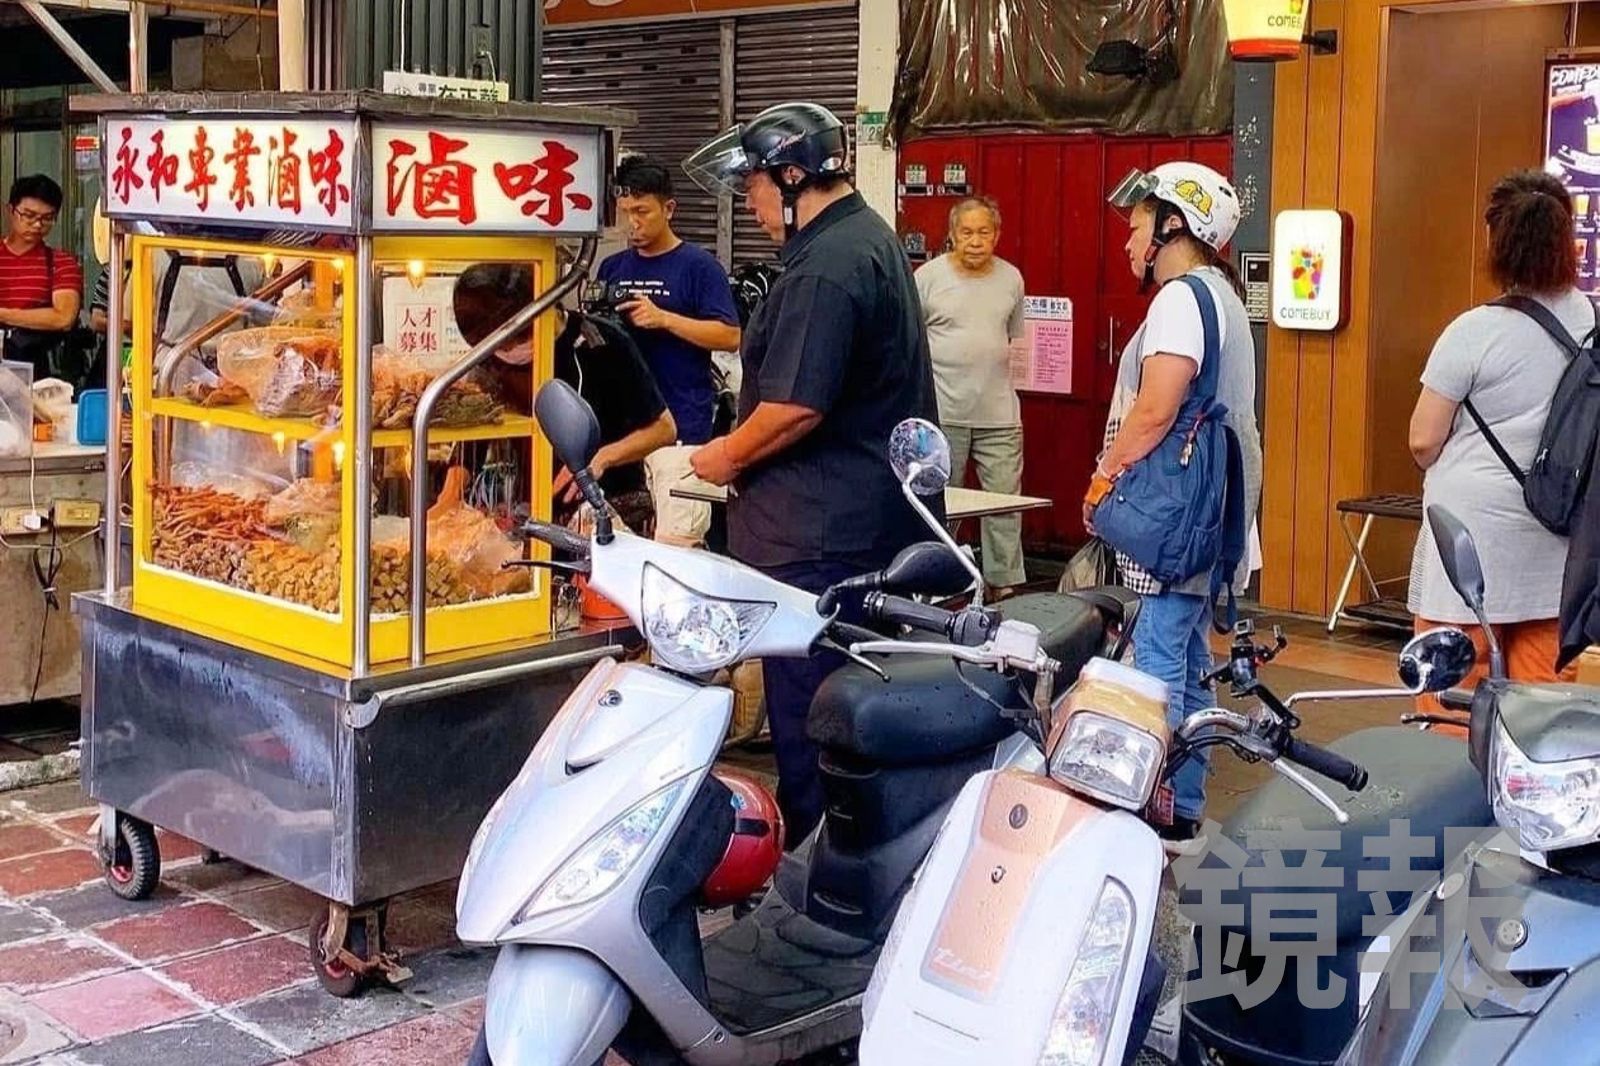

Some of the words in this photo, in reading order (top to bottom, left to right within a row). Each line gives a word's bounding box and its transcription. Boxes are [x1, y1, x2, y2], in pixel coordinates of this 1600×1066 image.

[112, 126, 349, 217] 永和專業滷味
[387, 132, 593, 226] 滷味
[401, 307, 437, 328] 人才
[1280, 306, 1330, 321] COMEBUY
